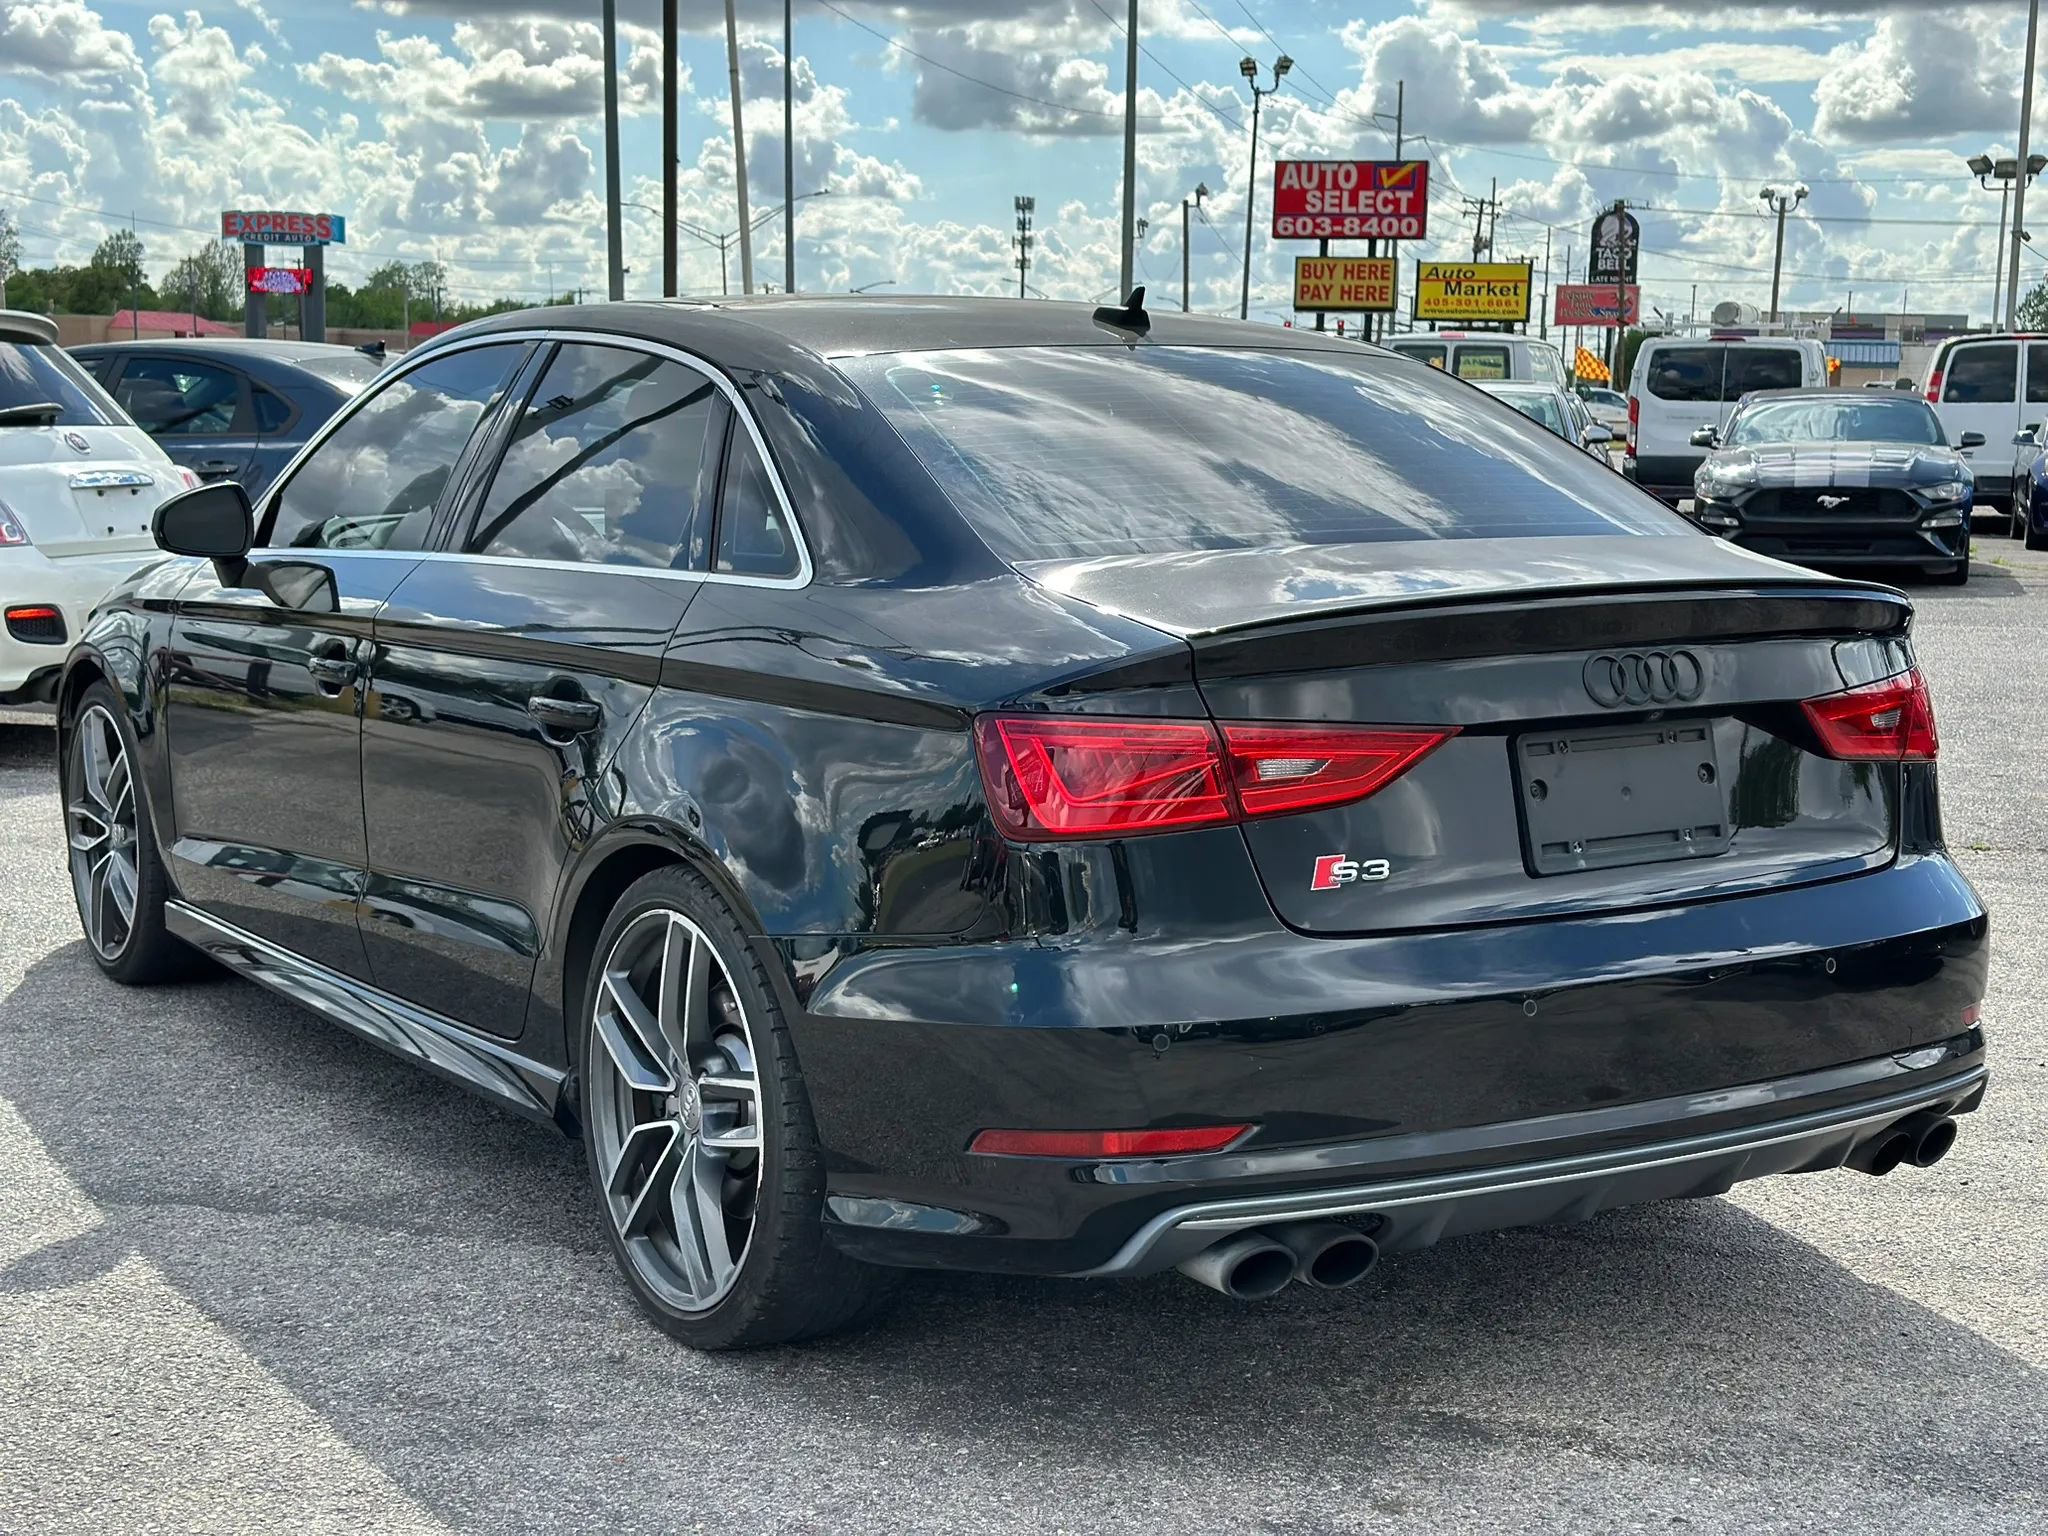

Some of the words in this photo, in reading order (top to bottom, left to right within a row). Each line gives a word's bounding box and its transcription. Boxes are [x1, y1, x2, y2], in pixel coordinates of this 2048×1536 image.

[1280, 163, 1358, 190] AUTO
[1305, 190, 1414, 214] SELECT
[223, 213, 332, 240] EXPRESS
[1276, 216, 1419, 236] 603-8400
[243, 233, 280, 241] CREDIT
[285, 234, 312, 242] AUTO
[1301, 263, 1338, 280] BUY
[1343, 264, 1391, 281] HERE
[1425, 266, 1476, 279] Auto
[1300, 284, 1333, 301] PAY
[1340, 285, 1390, 302] HERE
[1444, 281, 1520, 297] Market
[1329, 859, 1390, 884] S3
